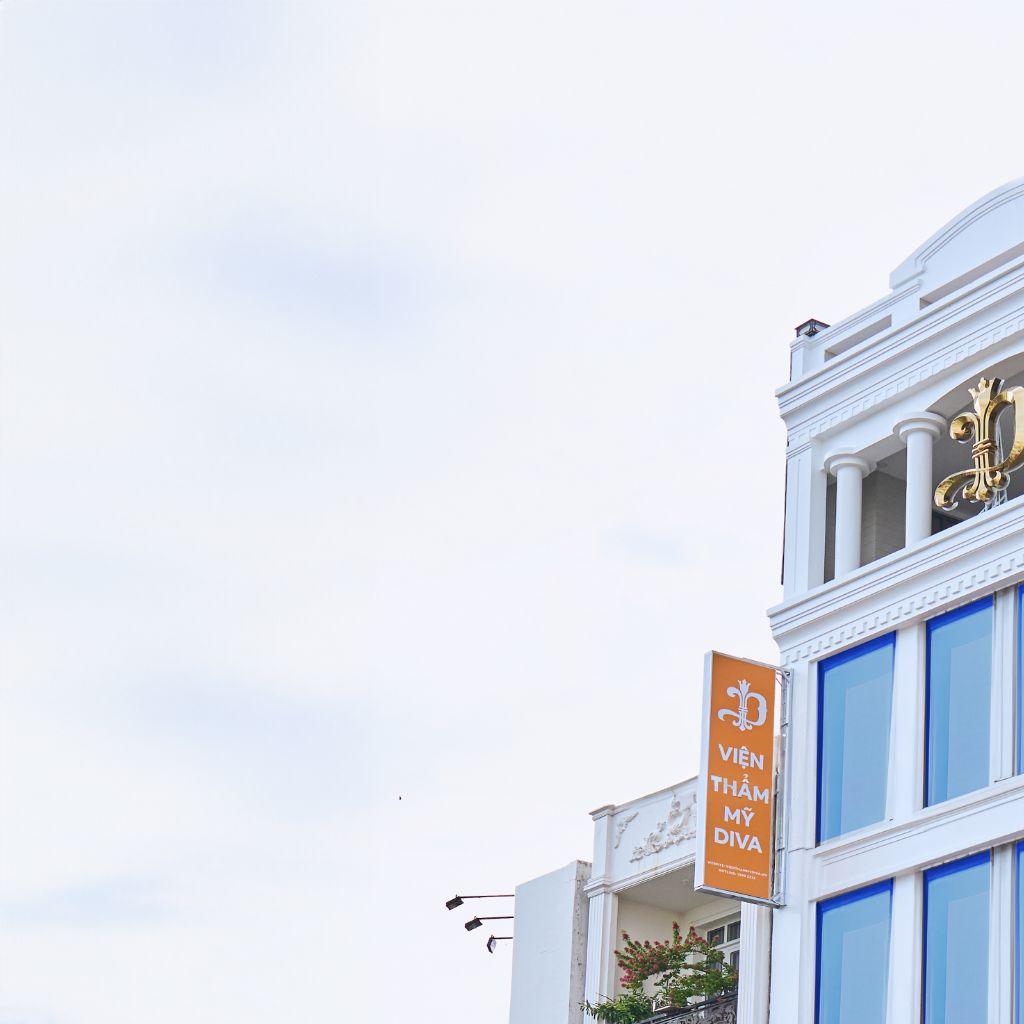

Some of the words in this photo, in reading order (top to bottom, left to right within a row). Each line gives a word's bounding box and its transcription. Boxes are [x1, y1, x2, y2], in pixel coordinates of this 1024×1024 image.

[718, 743, 764, 770] VIỆN
[711, 773, 770, 804] THẨM
[724, 805, 755, 828] MỸ
[714, 827, 763, 854] DIVA
